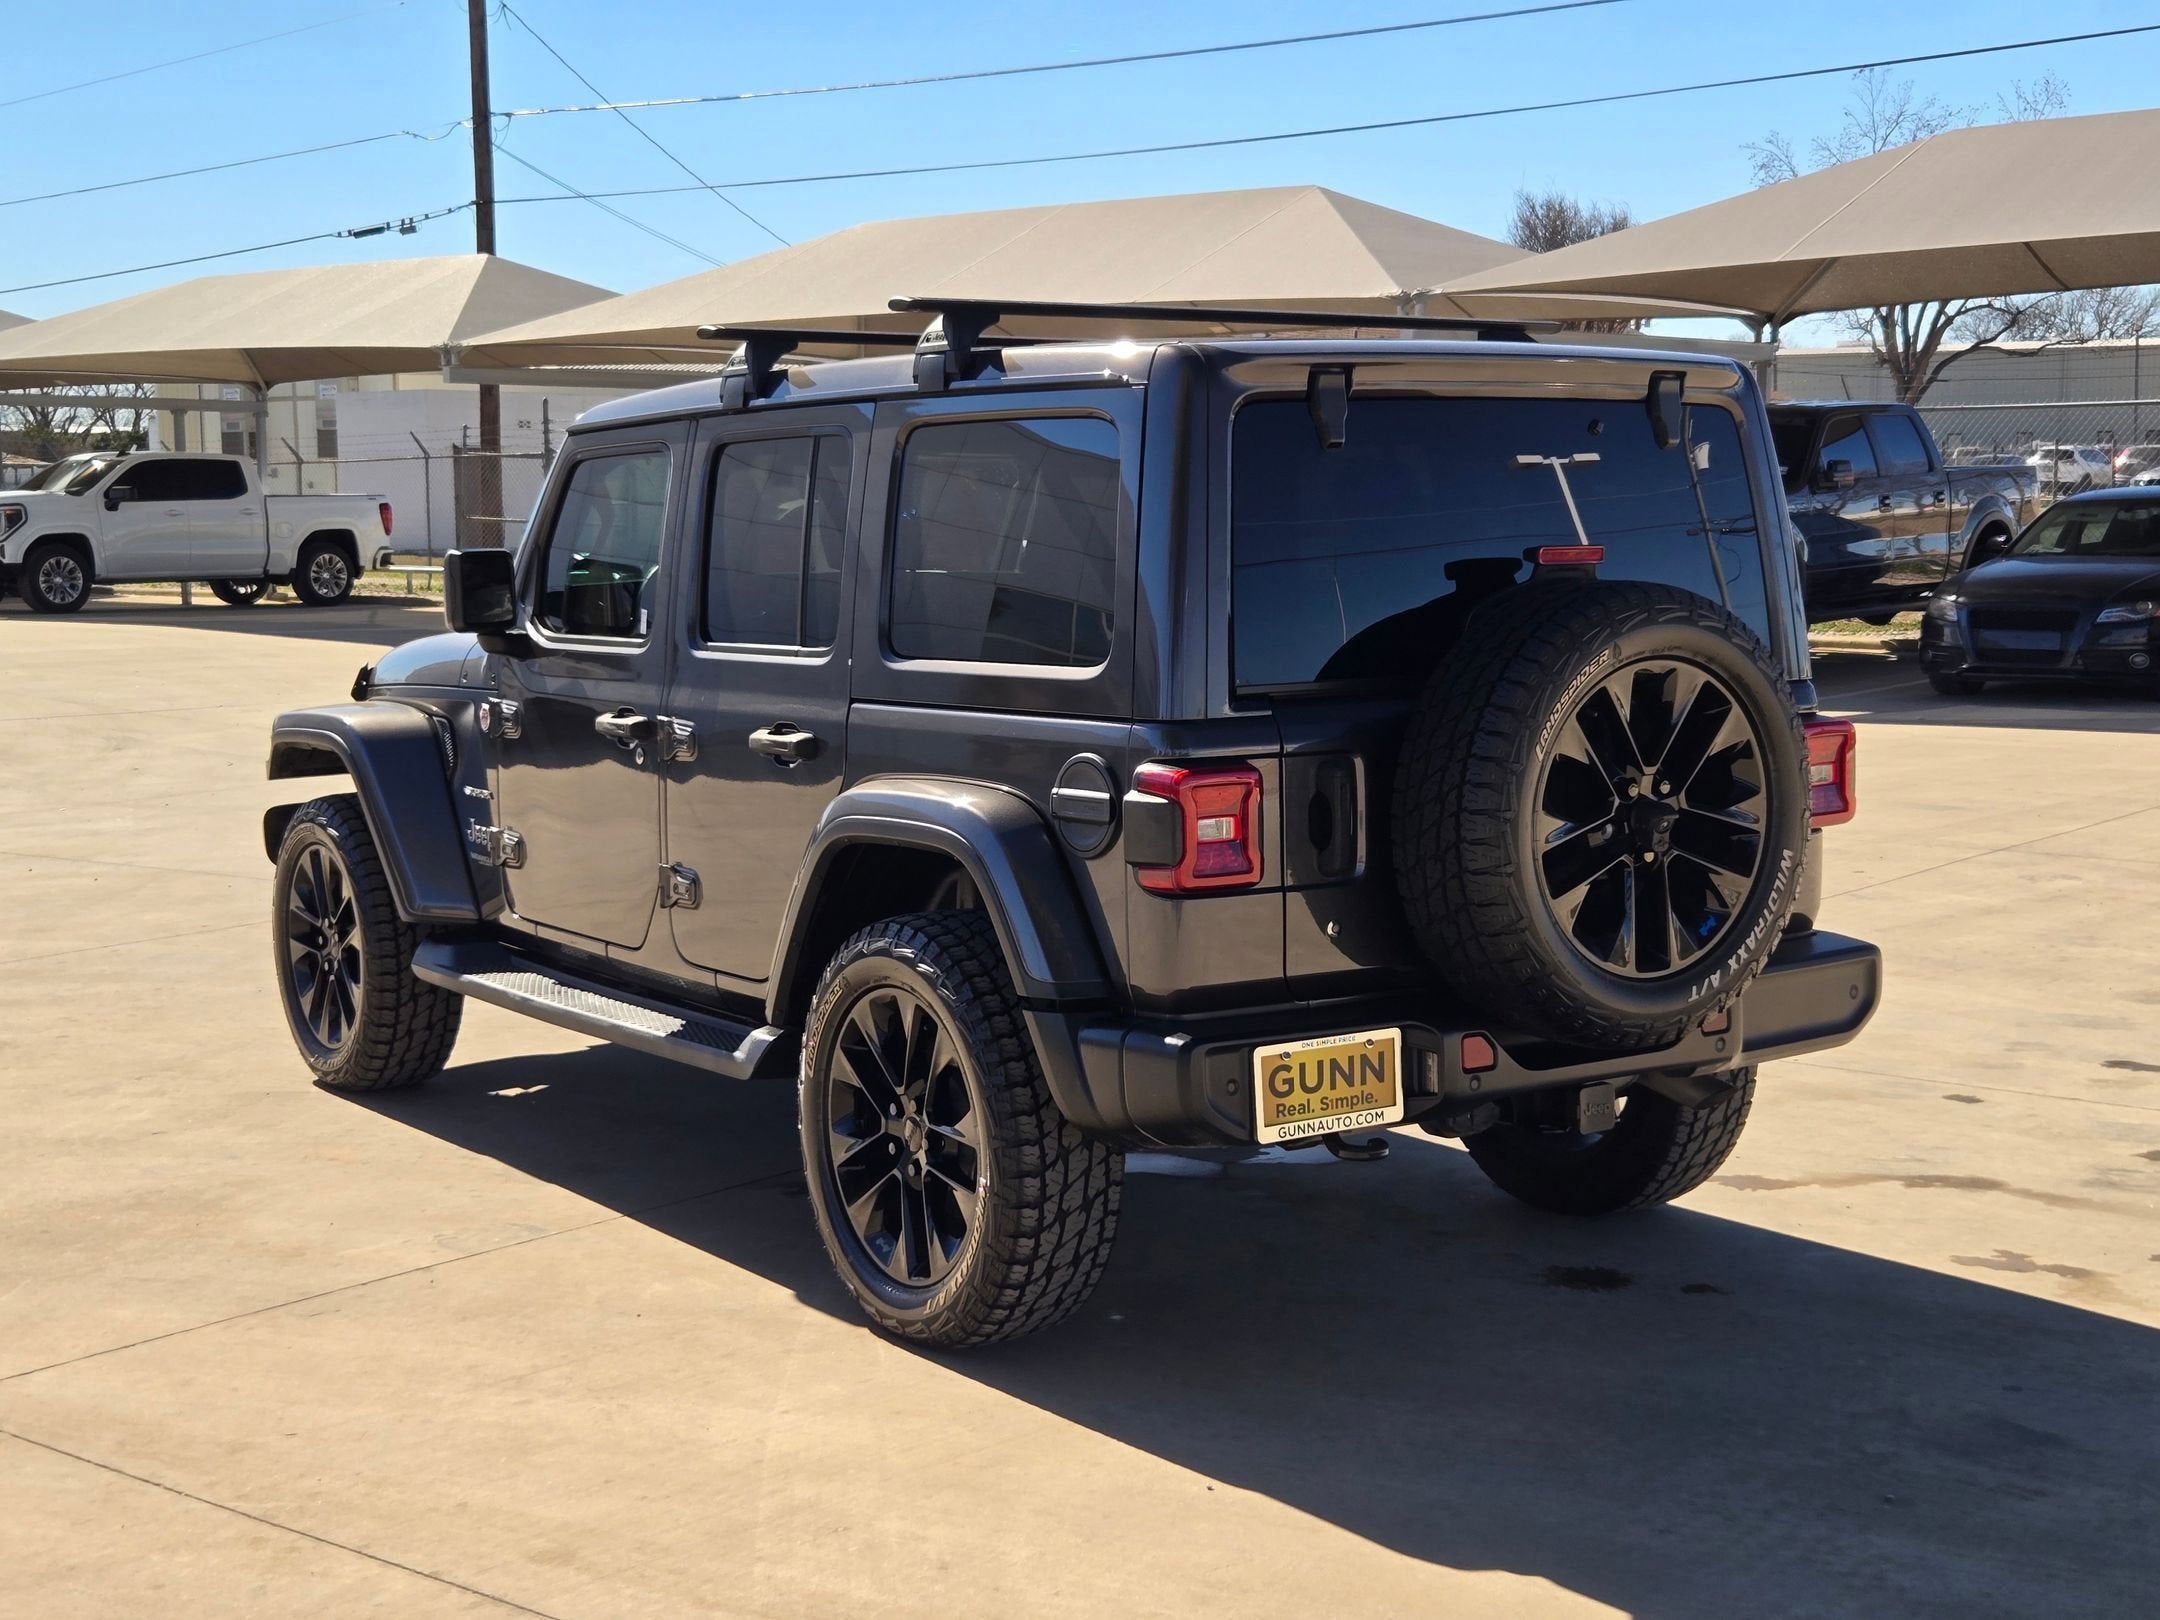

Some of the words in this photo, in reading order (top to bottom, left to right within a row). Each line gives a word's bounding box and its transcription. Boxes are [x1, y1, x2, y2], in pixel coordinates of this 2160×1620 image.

[1535, 648, 1610, 762] LANDSPIDER
[1727, 849, 1794, 976] WILDTRAXX
[1687, 969, 1721, 1002] A/T
[1301, 1041, 1314, 1049] ONE
[1316, 1038, 1337, 1047] SIMPLE
[1338, 1035, 1356, 1043] PRICE
[1268, 1051, 1385, 1099] GUNN
[1276, 1098, 1315, 1118] Real.
[1584, 1103, 1610, 1115] Jeep
[1278, 1110, 1385, 1139] GUNNAUTO.COM
